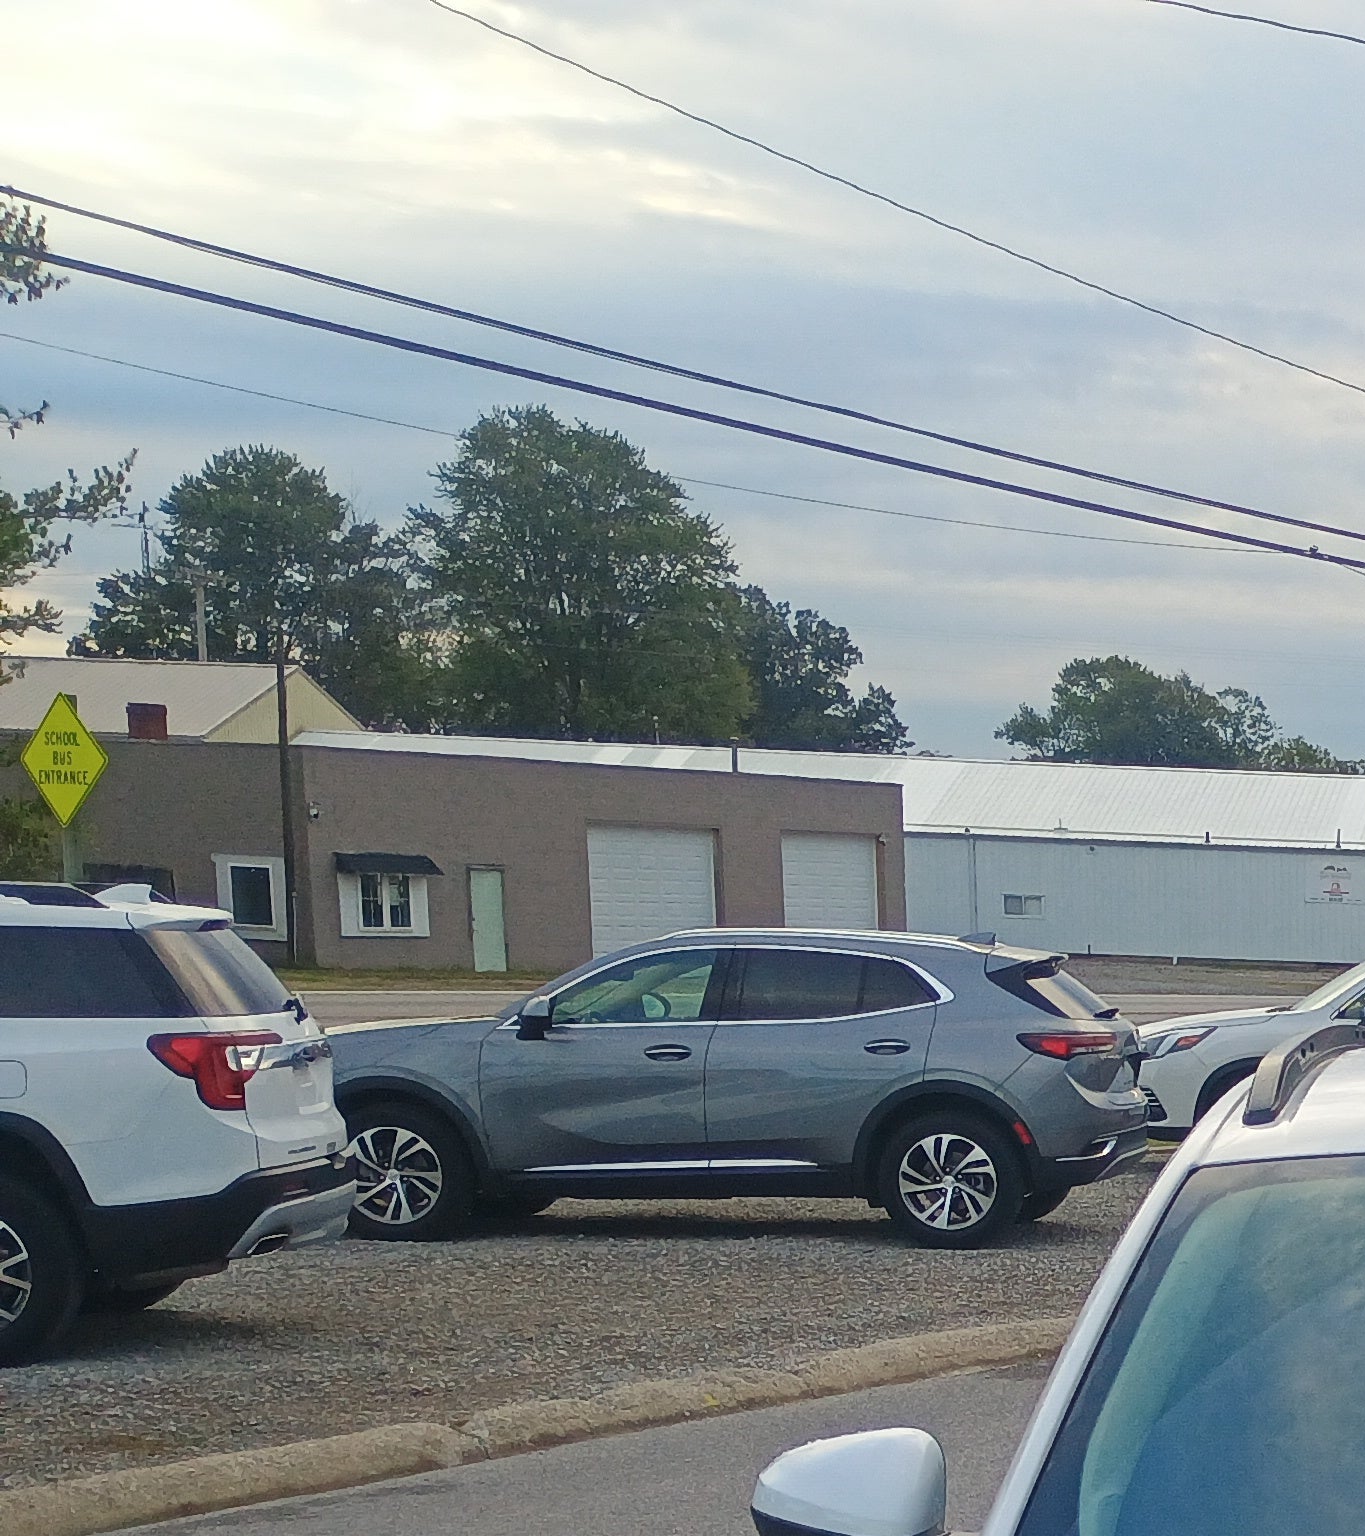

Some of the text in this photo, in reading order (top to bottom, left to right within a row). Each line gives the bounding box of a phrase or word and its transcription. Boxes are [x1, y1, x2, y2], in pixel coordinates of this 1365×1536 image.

[44, 731, 80, 746] SCHOOL
[53, 751, 73, 765] BUS
[38, 770, 89, 785] ENTRANCE
